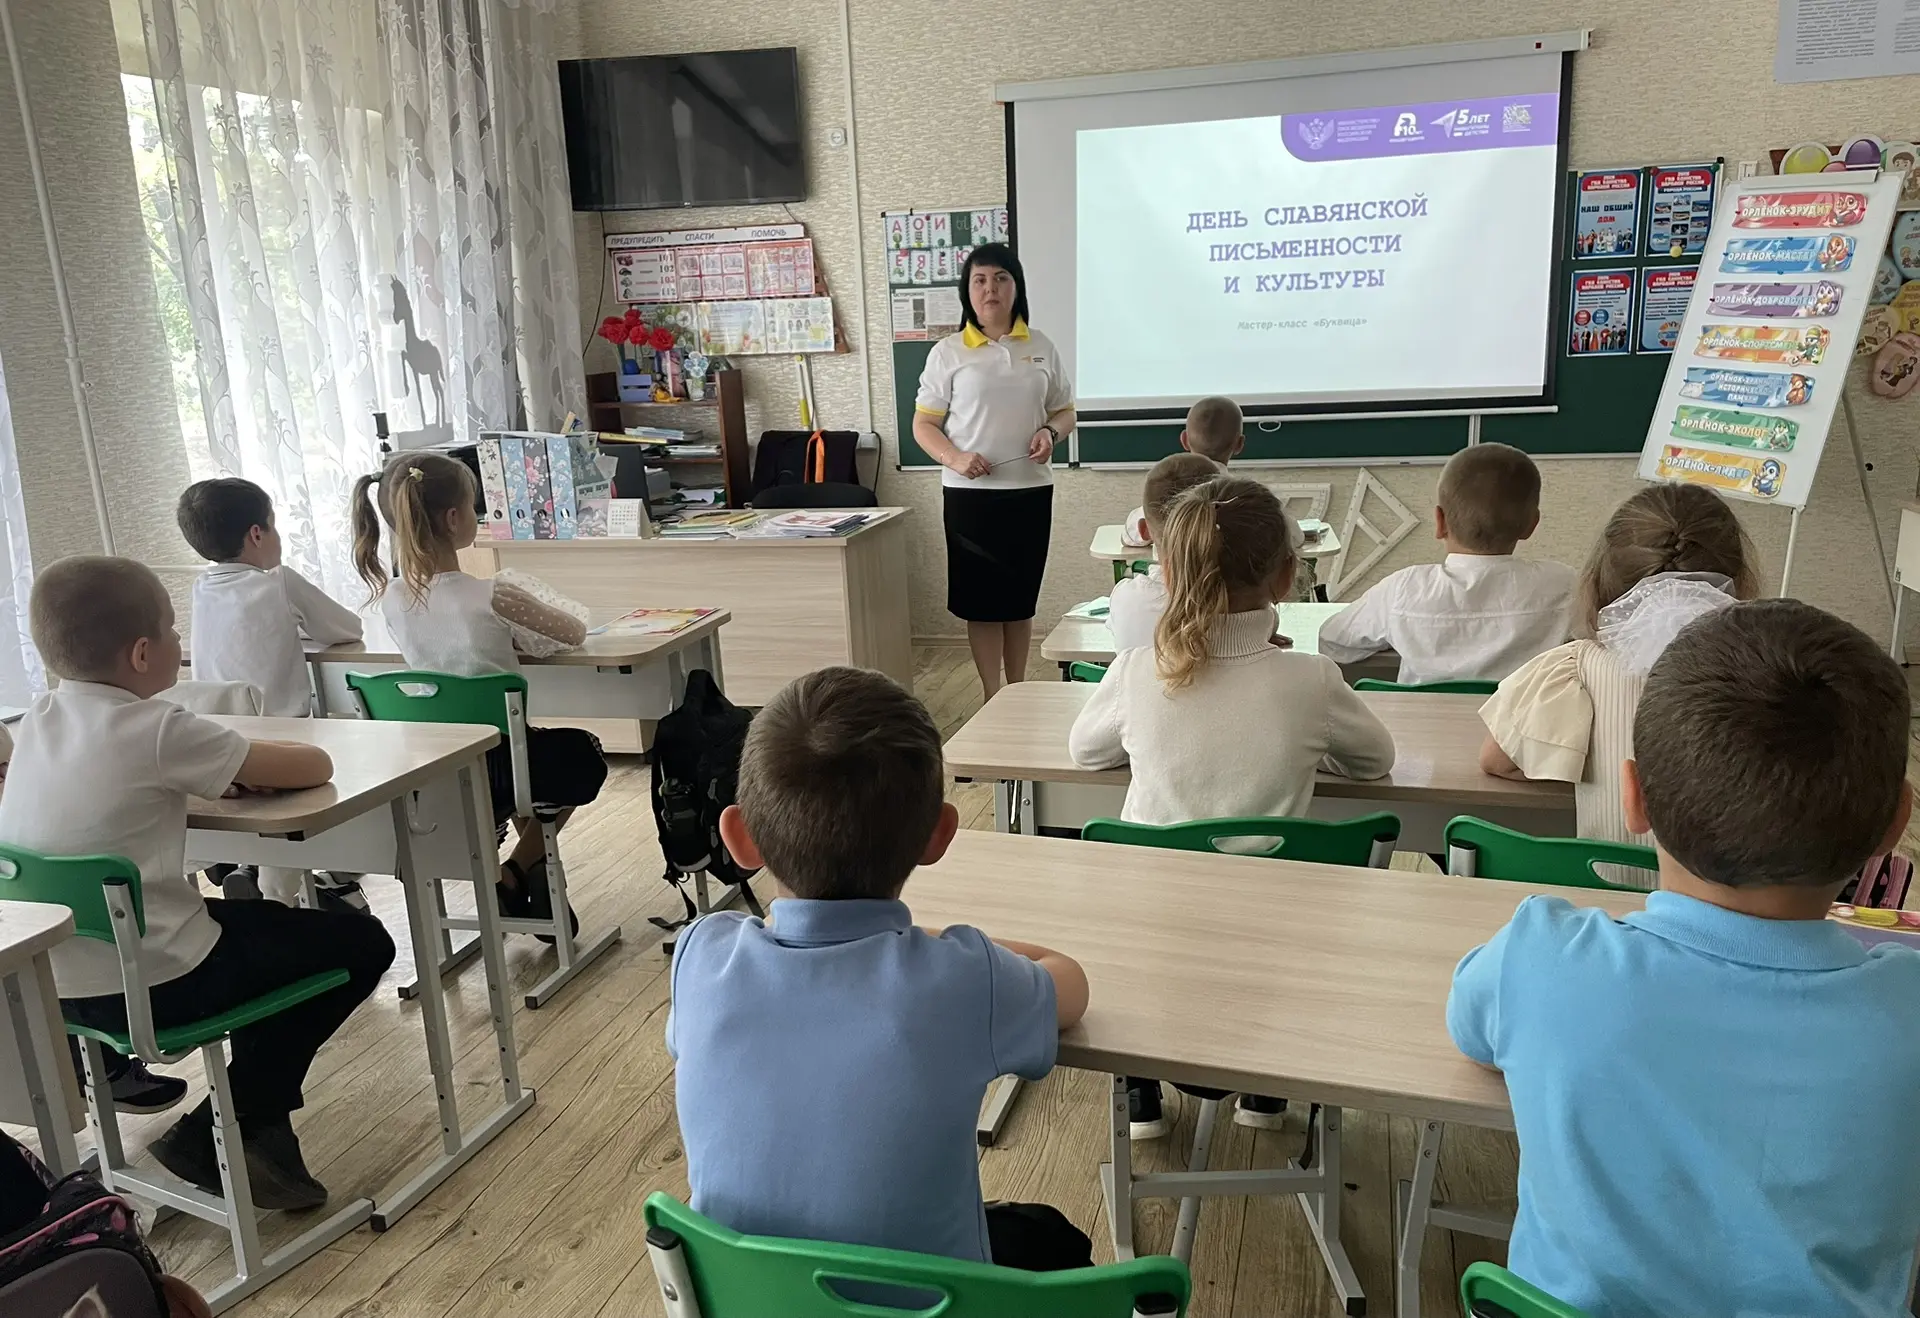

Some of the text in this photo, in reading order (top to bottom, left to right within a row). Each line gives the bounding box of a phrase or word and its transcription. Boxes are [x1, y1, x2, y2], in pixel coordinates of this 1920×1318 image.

[1186, 192, 1429, 233] ДЕНЬ СЛАВЯНСКОЙ
[1581, 201, 1634, 213] НАШ ОБЩИЙ
[892, 217, 945, 232] А О И
[611, 228, 787, 245] ПРЕДУПРЕДИТЬ СПАСТИ ПОМОЧЬ
[1209, 234, 1402, 262] ПИСЬМЕННОСТИ
[1727, 250, 1817, 262] ОРЛЁНОК-МАСТЕР
[1224, 269, 1386, 293] И КУЛЬТУРЫ
[1237, 320, 1308, 331] Мастер-класс
[1680, 417, 1768, 438] ОРЛЁНОК-ЭКОЛОГ
[1665, 456, 1750, 479] ОРЛЁНОК-ЛИДЕР
